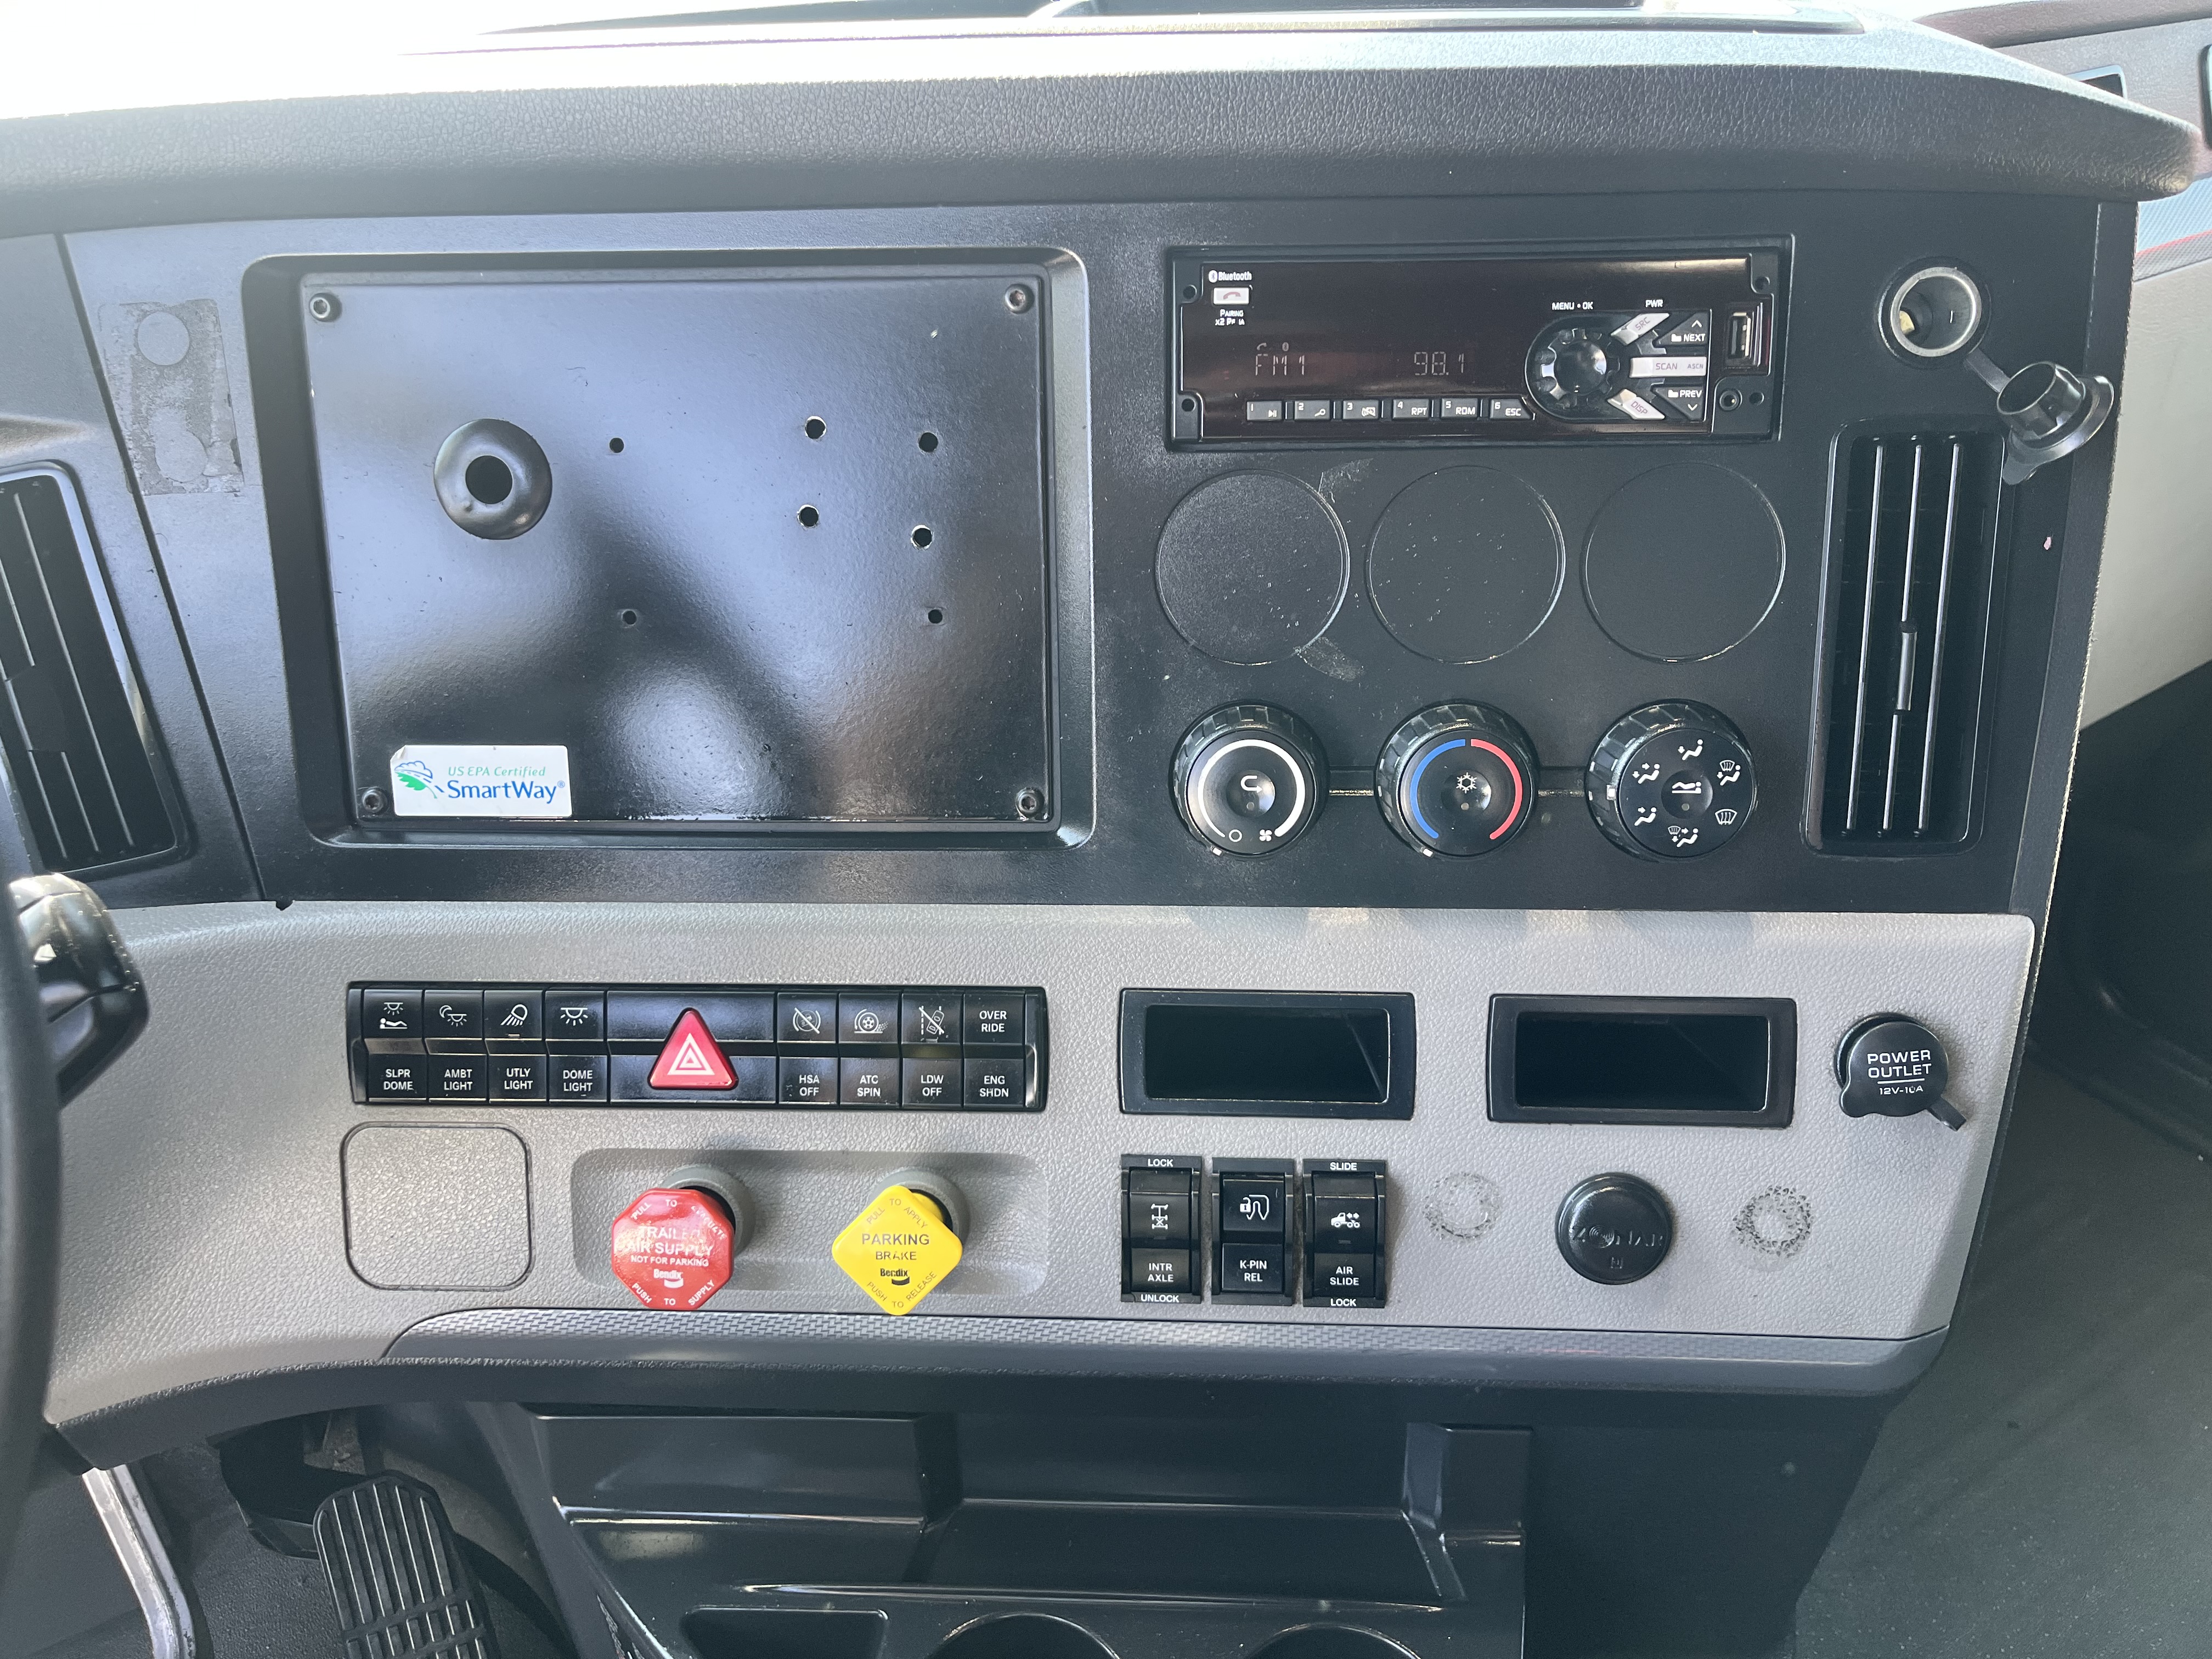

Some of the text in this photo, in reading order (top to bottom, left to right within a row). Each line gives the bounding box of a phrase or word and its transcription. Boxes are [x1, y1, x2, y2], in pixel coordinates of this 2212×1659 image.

[1218, 271, 1252, 281] Bluetooth
[1552, 302, 1593, 311] MENU OK
[1645, 299, 1663, 308] PWR
[1635, 317, 1651, 331] SRC
[1683, 334, 1706, 342] NEXT
[1414, 352, 1465, 375] 98.1
[1679, 390, 1702, 398] PREV
[1347, 402, 1353, 410] 3
[1411, 407, 1427, 415] RPT
[1630, 400, 1648, 415] DISP
[1505, 408, 1522, 416] ESC
[448, 766, 546, 777] US EPA Certified
[979, 1010, 1007, 1020] OVER
[981, 1022, 1006, 1033] RIDE
[1867, 1049, 1932, 1064] POWER
[385, 1069, 411, 1079] SLPR
[444, 1069, 473, 1079] AMBT
[506, 1068, 531, 1078] UTLY
[562, 1069, 593, 1080] DOME
[1867, 1063, 1932, 1079] OUTLET
[799, 1074, 820, 1084] HSA
[860, 1074, 878, 1084] ATC
[920, 1074, 944, 1084] LDW
[983, 1075, 1006, 1085] ENG
[383, 1081, 414, 1091] DOME
[444, 1081, 473, 1091] LIGHT
[504, 1080, 533, 1091] LIGHT
[563, 1082, 593, 1092] LIGHT
[1878, 1085, 1924, 1096] 12V-10A
[799, 1086, 820, 1096] OFF
[857, 1086, 881, 1097] SPIN
[922, 1086, 943, 1096] OFF
[979, 1087, 1009, 1098] SHDN
[1147, 1158, 1173, 1167] LOCK
[1329, 1161, 1358, 1171] SLIDE
[630, 1201, 652, 1221] PULL
[665, 1199, 678, 1207] TO
[866, 1198, 928, 1229] PULL TO APPLY
[861, 1233, 930, 1246] PARKING
[628, 1240, 714, 1257] AIR SUPPLY
[875, 1250, 917, 1261] BRAKE
[631, 1255, 709, 1267] NOT FOR PARKING
[1239, 1260, 1267, 1270] K-PIN
[1148, 1262, 1173, 1272] INTR
[1335, 1266, 1353, 1275] AIR
[653, 1268, 682, 1279] Bendix
[880, 1268, 909, 1277] Bendix
[1244, 1272, 1263, 1282] REL
[1147, 1273, 1174, 1283] AXLE
[1330, 1277, 1359, 1286] SLIDE
[867, 1281, 888, 1302] PUSH
[906, 1271, 938, 1302] RELEASE
[632, 1279, 715, 1306] PUSH TO SUPPLY
[1141, 1294, 1180, 1303] UNLOCK
[1330, 1297, 1357, 1307] LOCK
